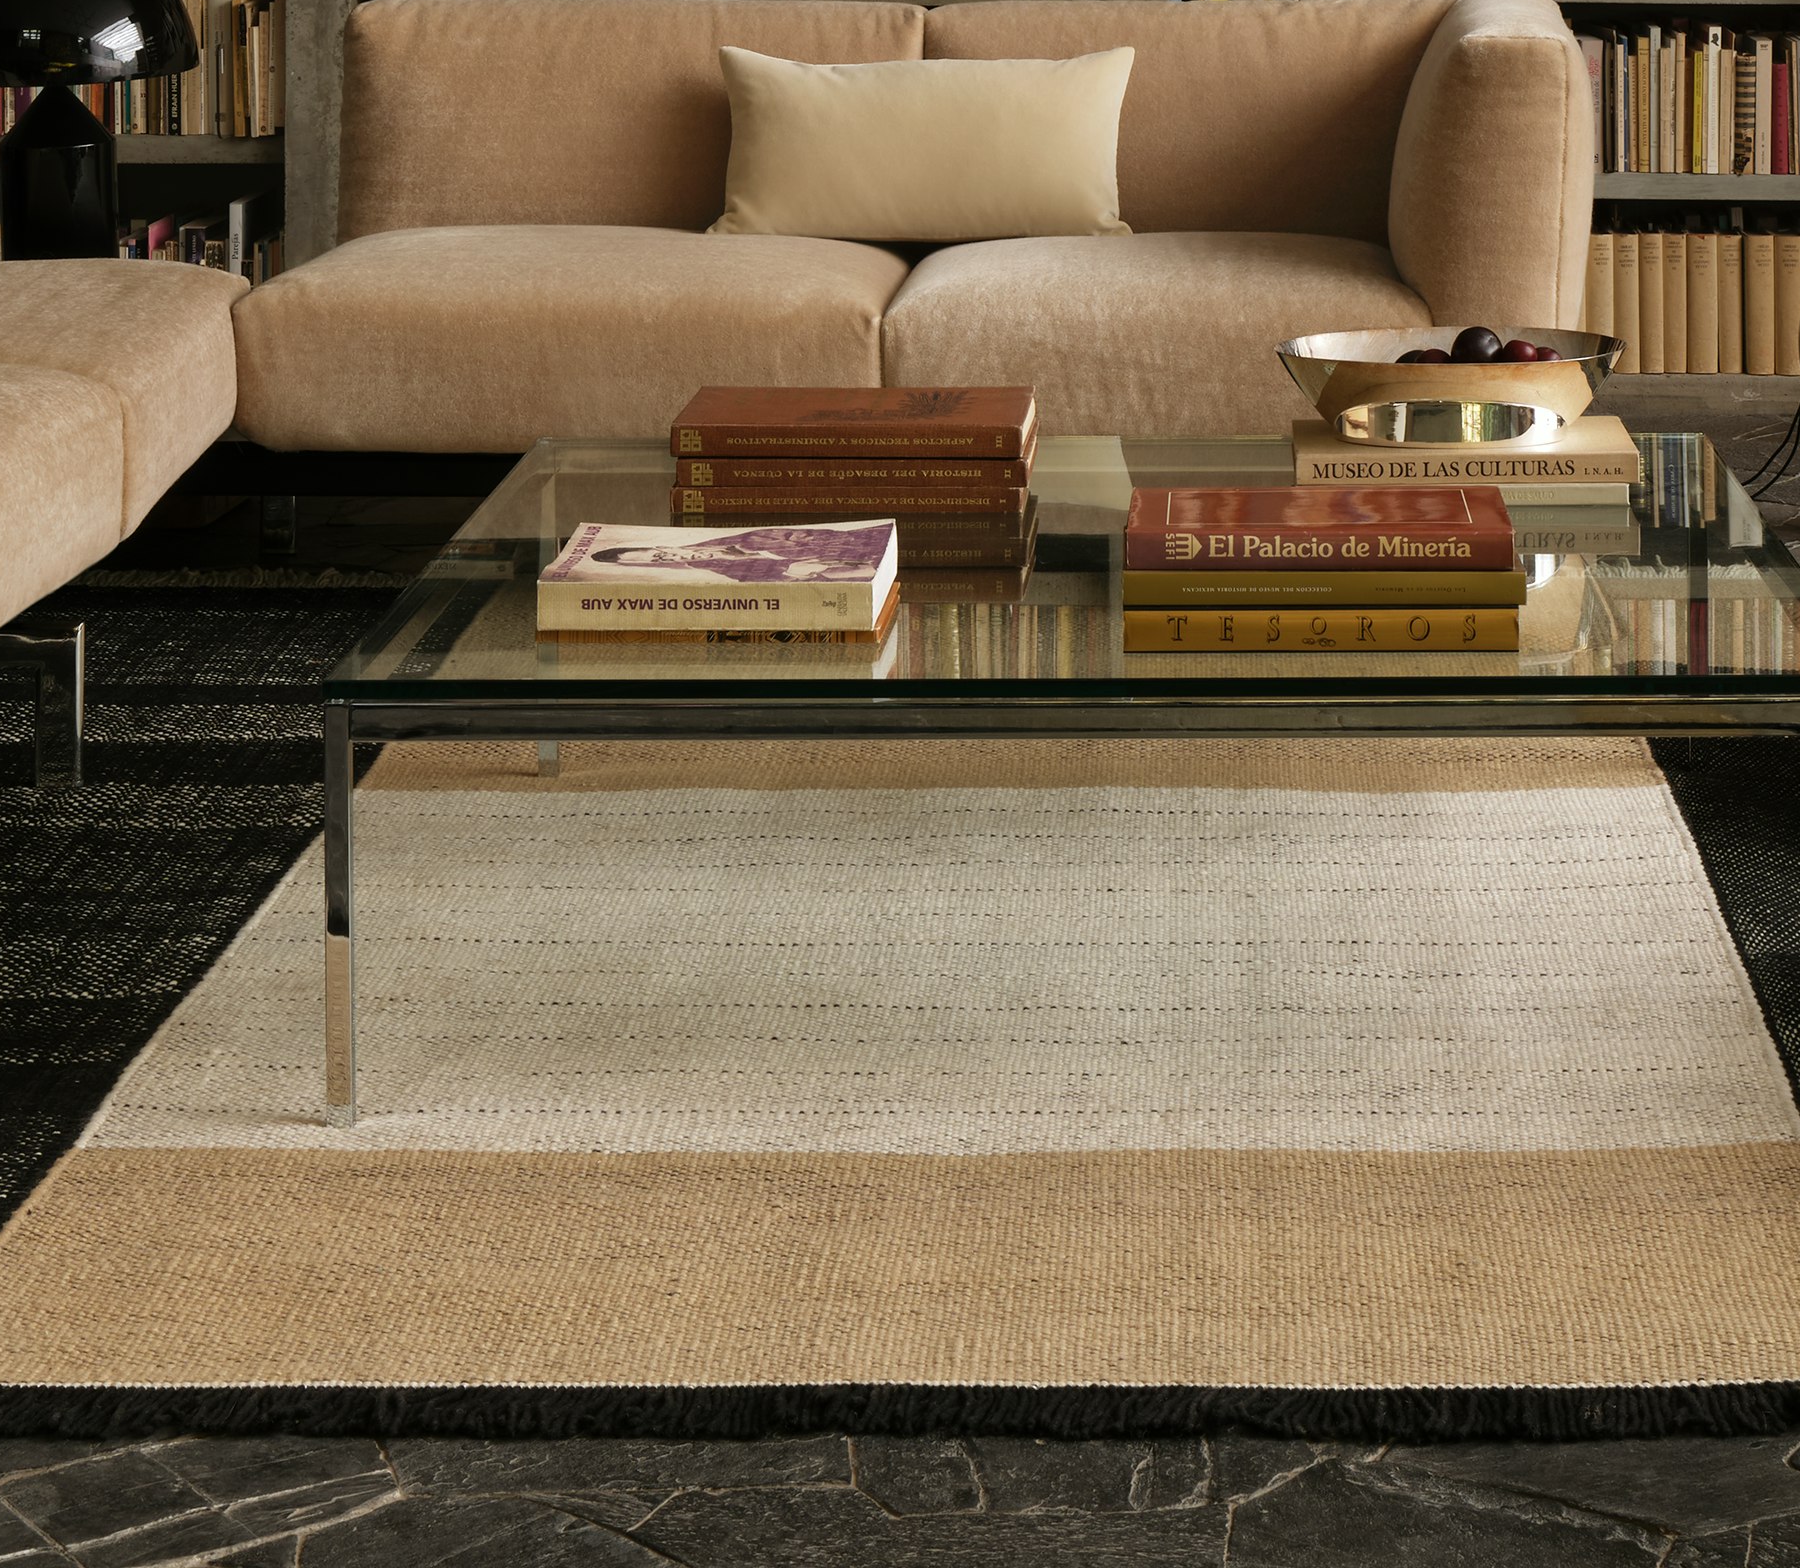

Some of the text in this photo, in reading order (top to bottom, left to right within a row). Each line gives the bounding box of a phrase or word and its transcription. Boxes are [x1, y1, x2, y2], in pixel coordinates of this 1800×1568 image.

[727, 437, 836, 446] ADMINISTRATIVOS
[839, 437, 847, 446] Y
[914, 437, 973, 446] ASPECTOS
[893, 470, 916, 478] DEL
[922, 469, 981, 478] HISTORIA
[1313, 462, 1383, 479] MUSEO
[1390, 462, 1416, 477] DE
[1424, 461, 1459, 477] LAS
[1466, 460, 1575, 477] CULTURAS
[733, 470, 782, 479] CUENCA
[829, 470, 886, 480] DESAGÜE
[1166, 533, 1175, 560] SEFI
[1208, 535, 1471, 558] El Palacio de Minería
[581, 599, 780, 610] EL UNIVERSO DE MAX AUB
[1167, 614, 1477, 644] TESOROS
